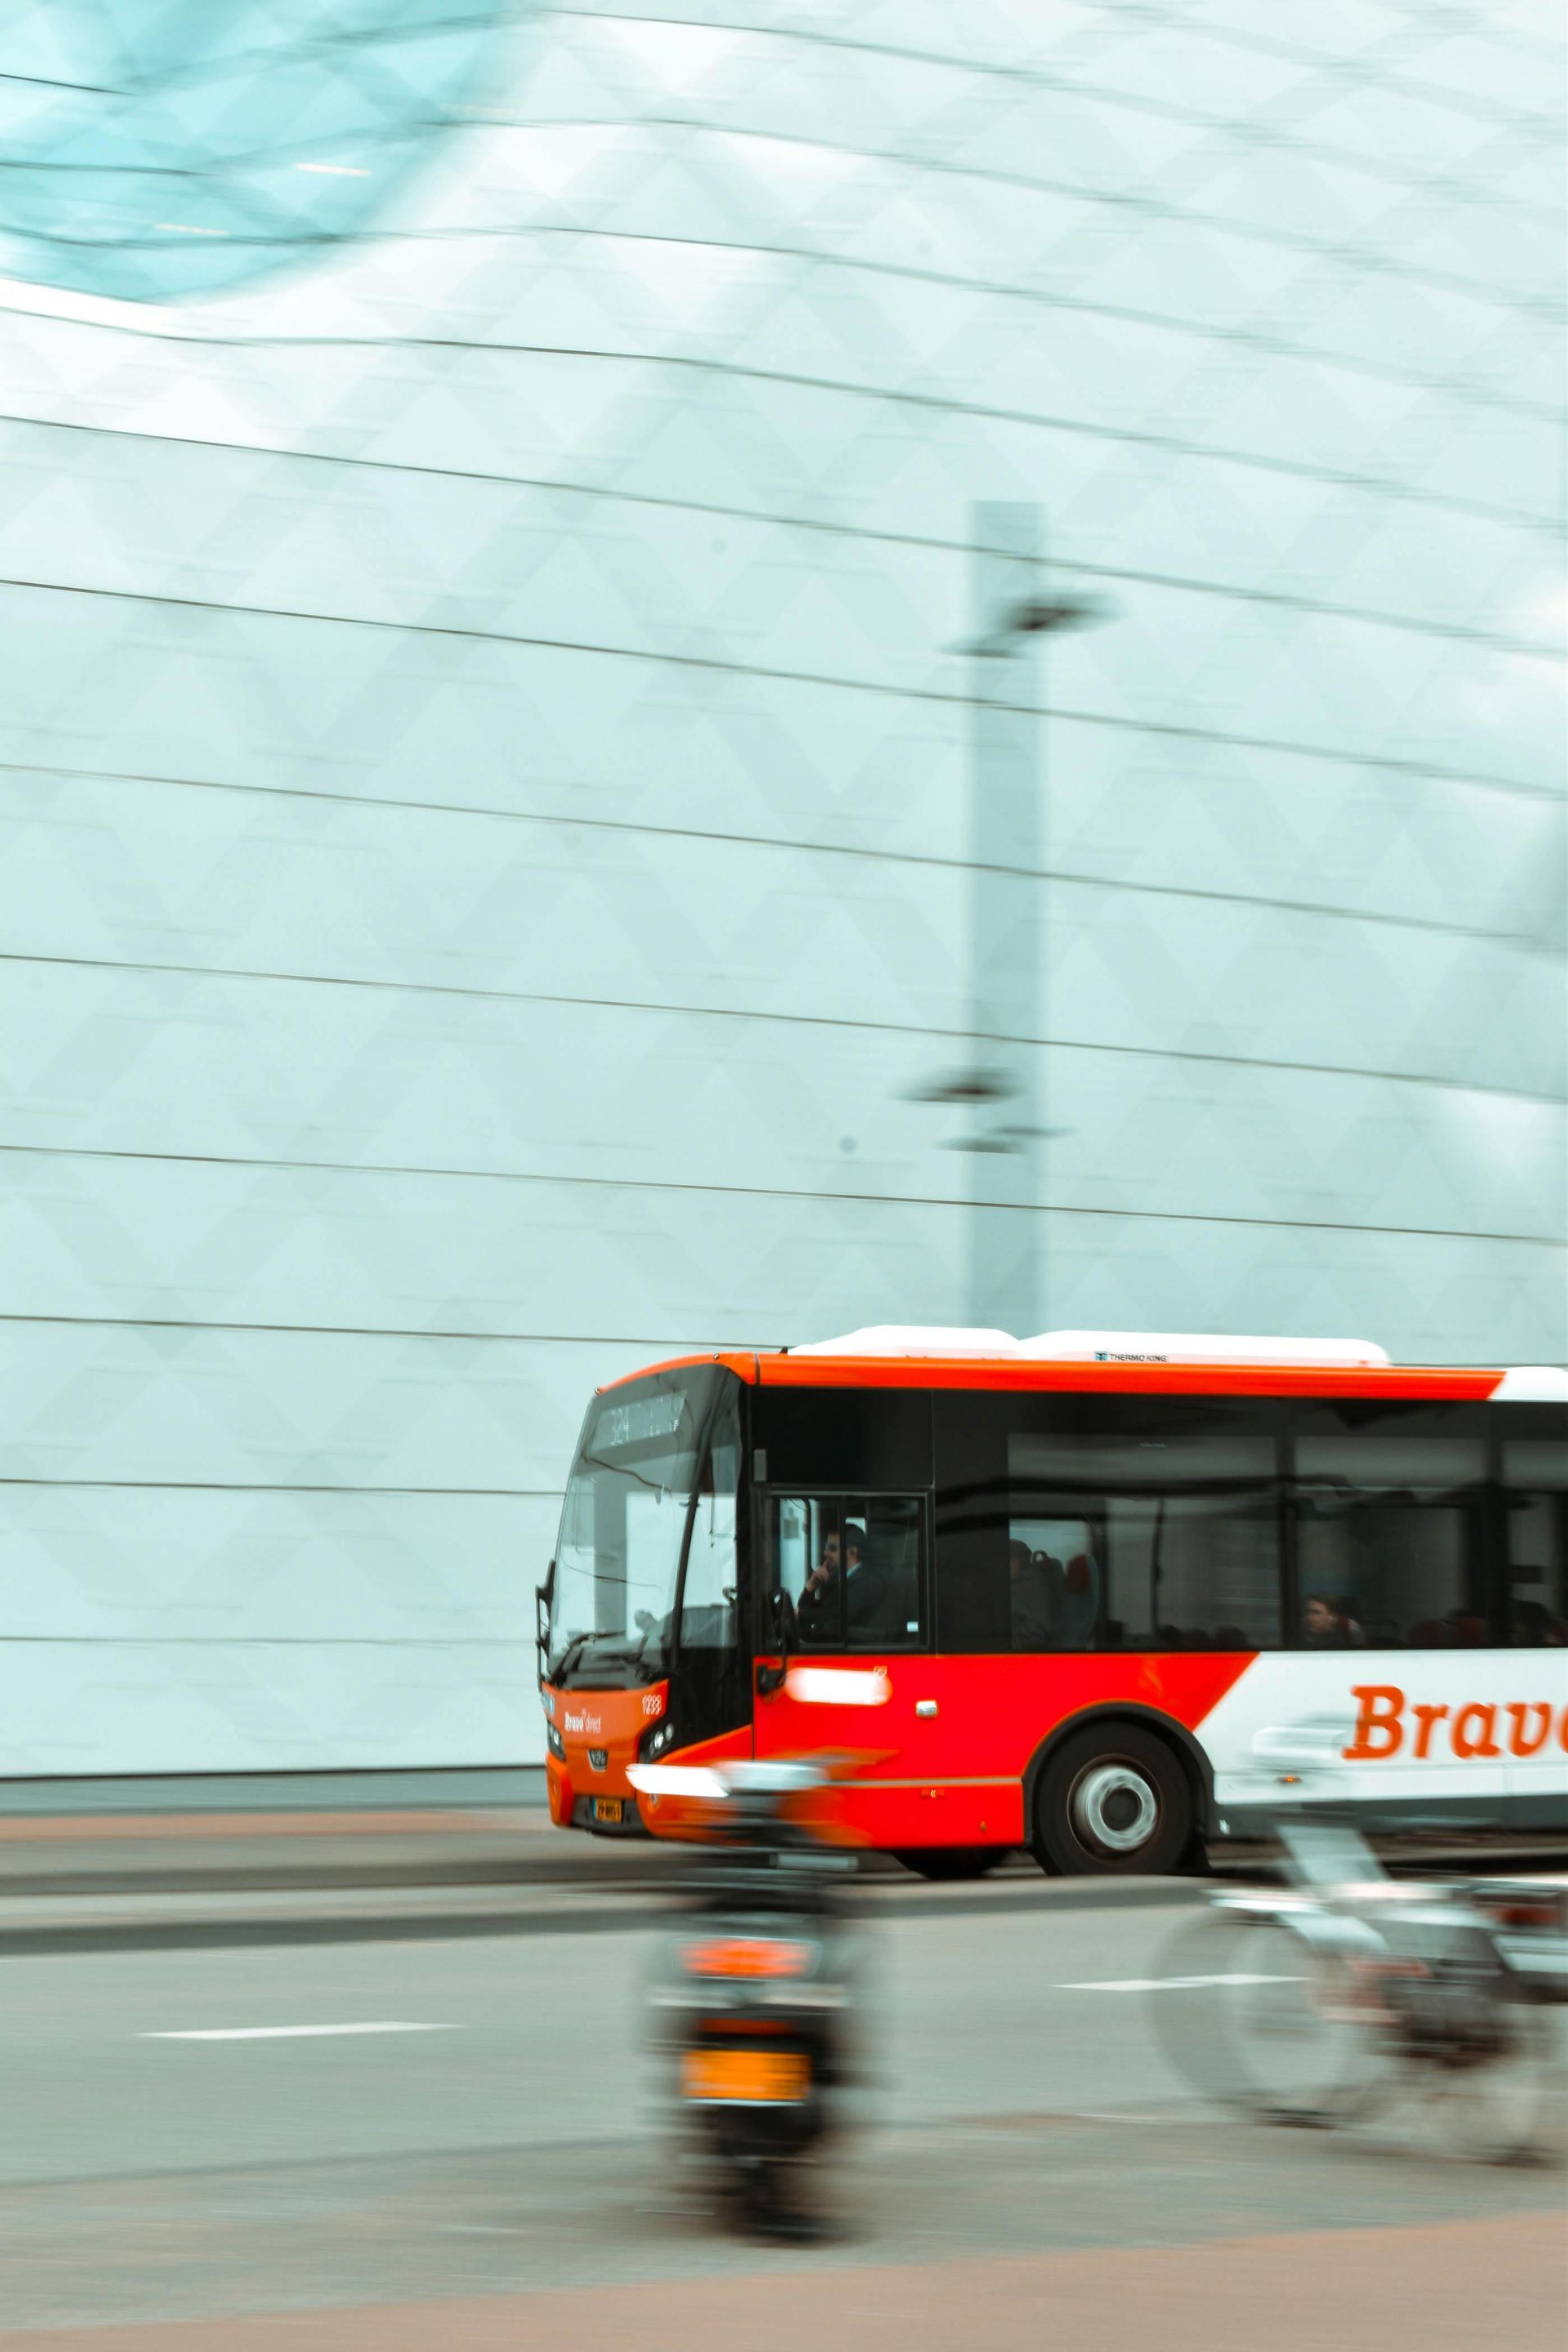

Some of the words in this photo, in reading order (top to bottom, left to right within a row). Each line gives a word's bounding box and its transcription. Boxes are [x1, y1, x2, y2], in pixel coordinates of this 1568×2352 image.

[1110, 1353, 1145, 1361] THERMO
[1147, 1354, 1168, 1362] KING
[1342, 1685, 1568, 1759] Brav
